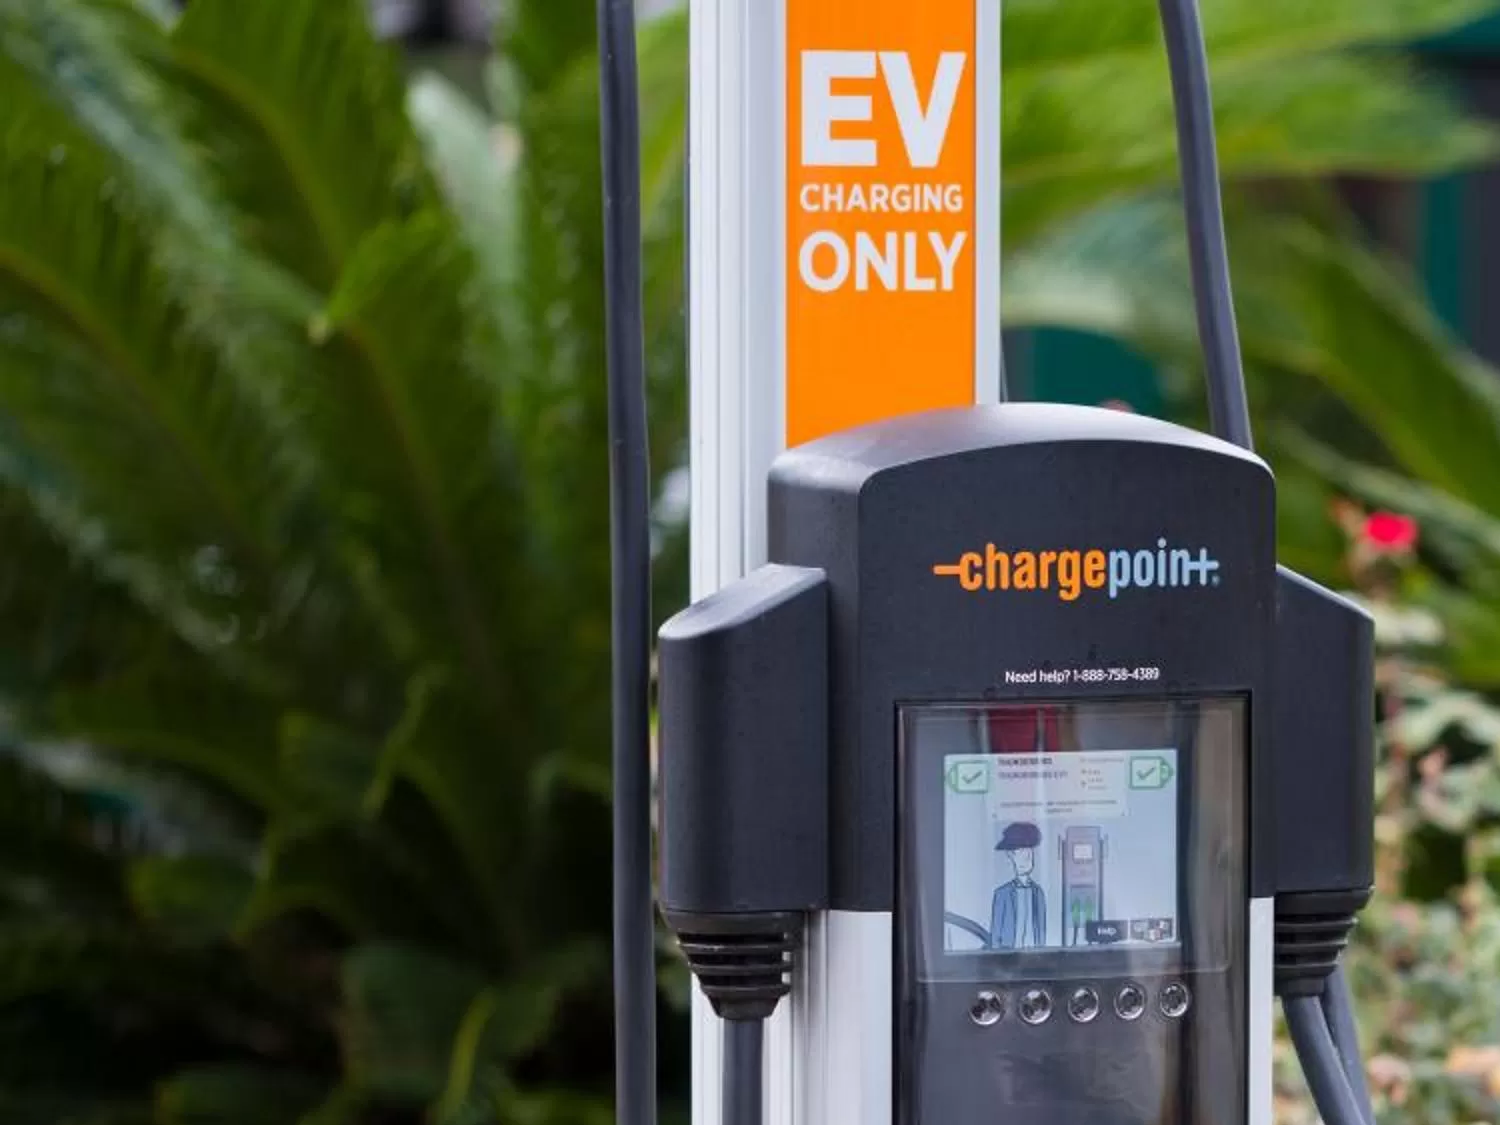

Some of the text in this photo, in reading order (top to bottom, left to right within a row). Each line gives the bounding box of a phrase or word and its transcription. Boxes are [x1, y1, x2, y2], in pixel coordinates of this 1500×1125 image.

[801, 50, 967, 168] EV
[800, 183, 963, 213] CHARGING
[799, 229, 967, 292] ONLY
[933, 537, 1220, 601] chargepoint
[1004, 667, 1160, 685] Need help? 1-888-758-4389
